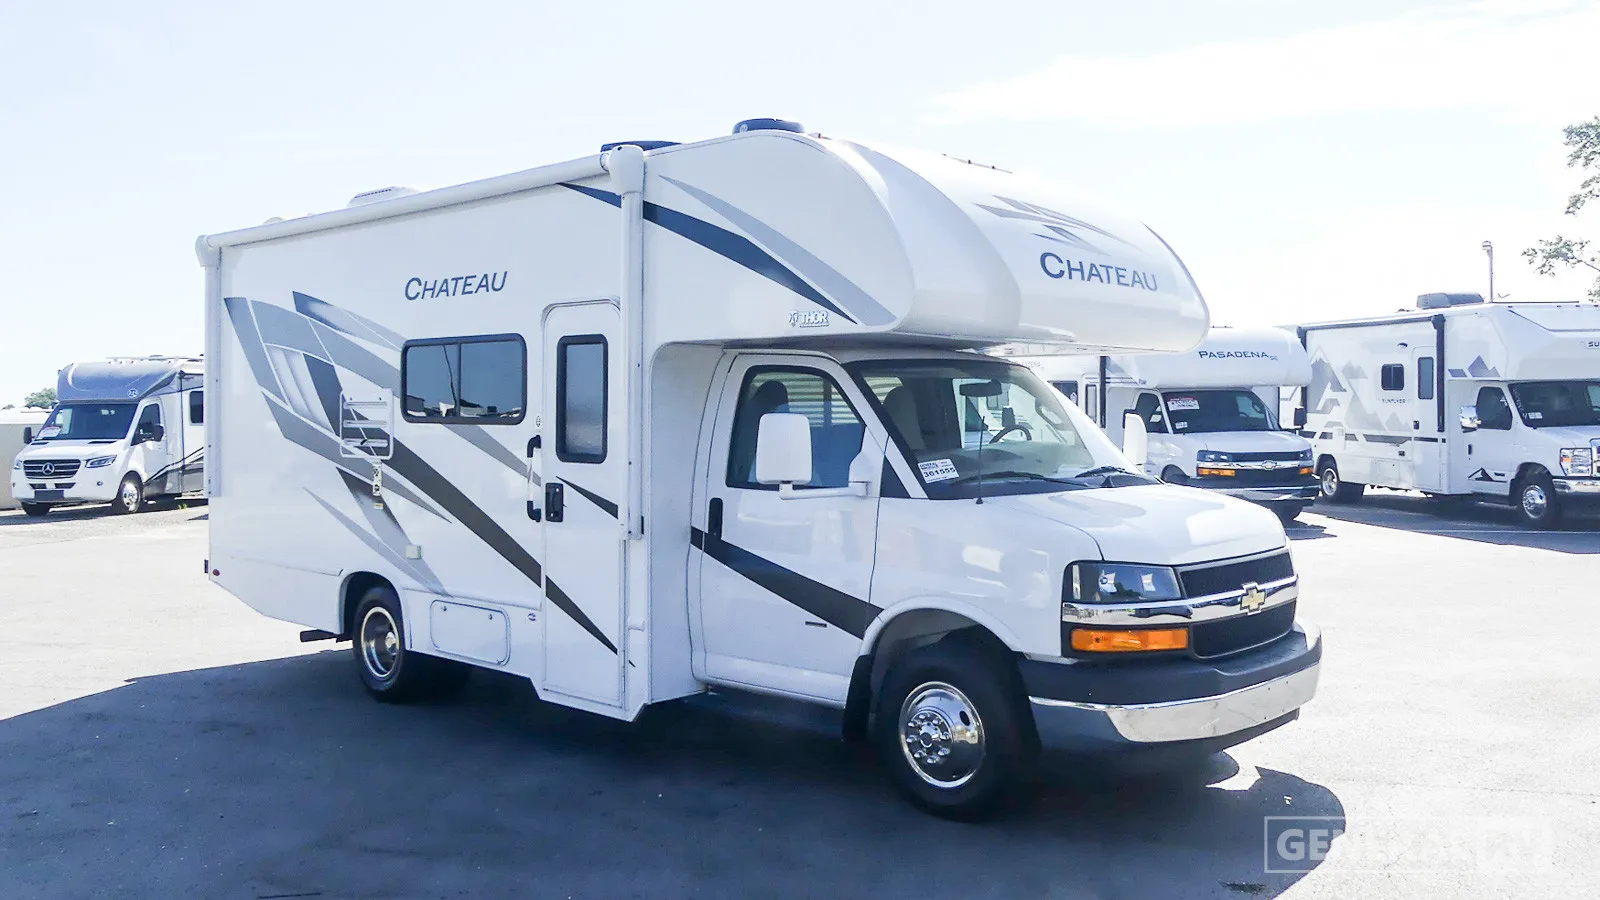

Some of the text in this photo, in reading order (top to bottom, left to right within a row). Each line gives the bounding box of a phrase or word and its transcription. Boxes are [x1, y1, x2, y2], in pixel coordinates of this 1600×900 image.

[1040, 251, 1158, 292] CHATEAU
[405, 270, 508, 301] CHATEAU
[800, 311, 829, 324] THOR
[1198, 350, 1269, 359] PASADENA
